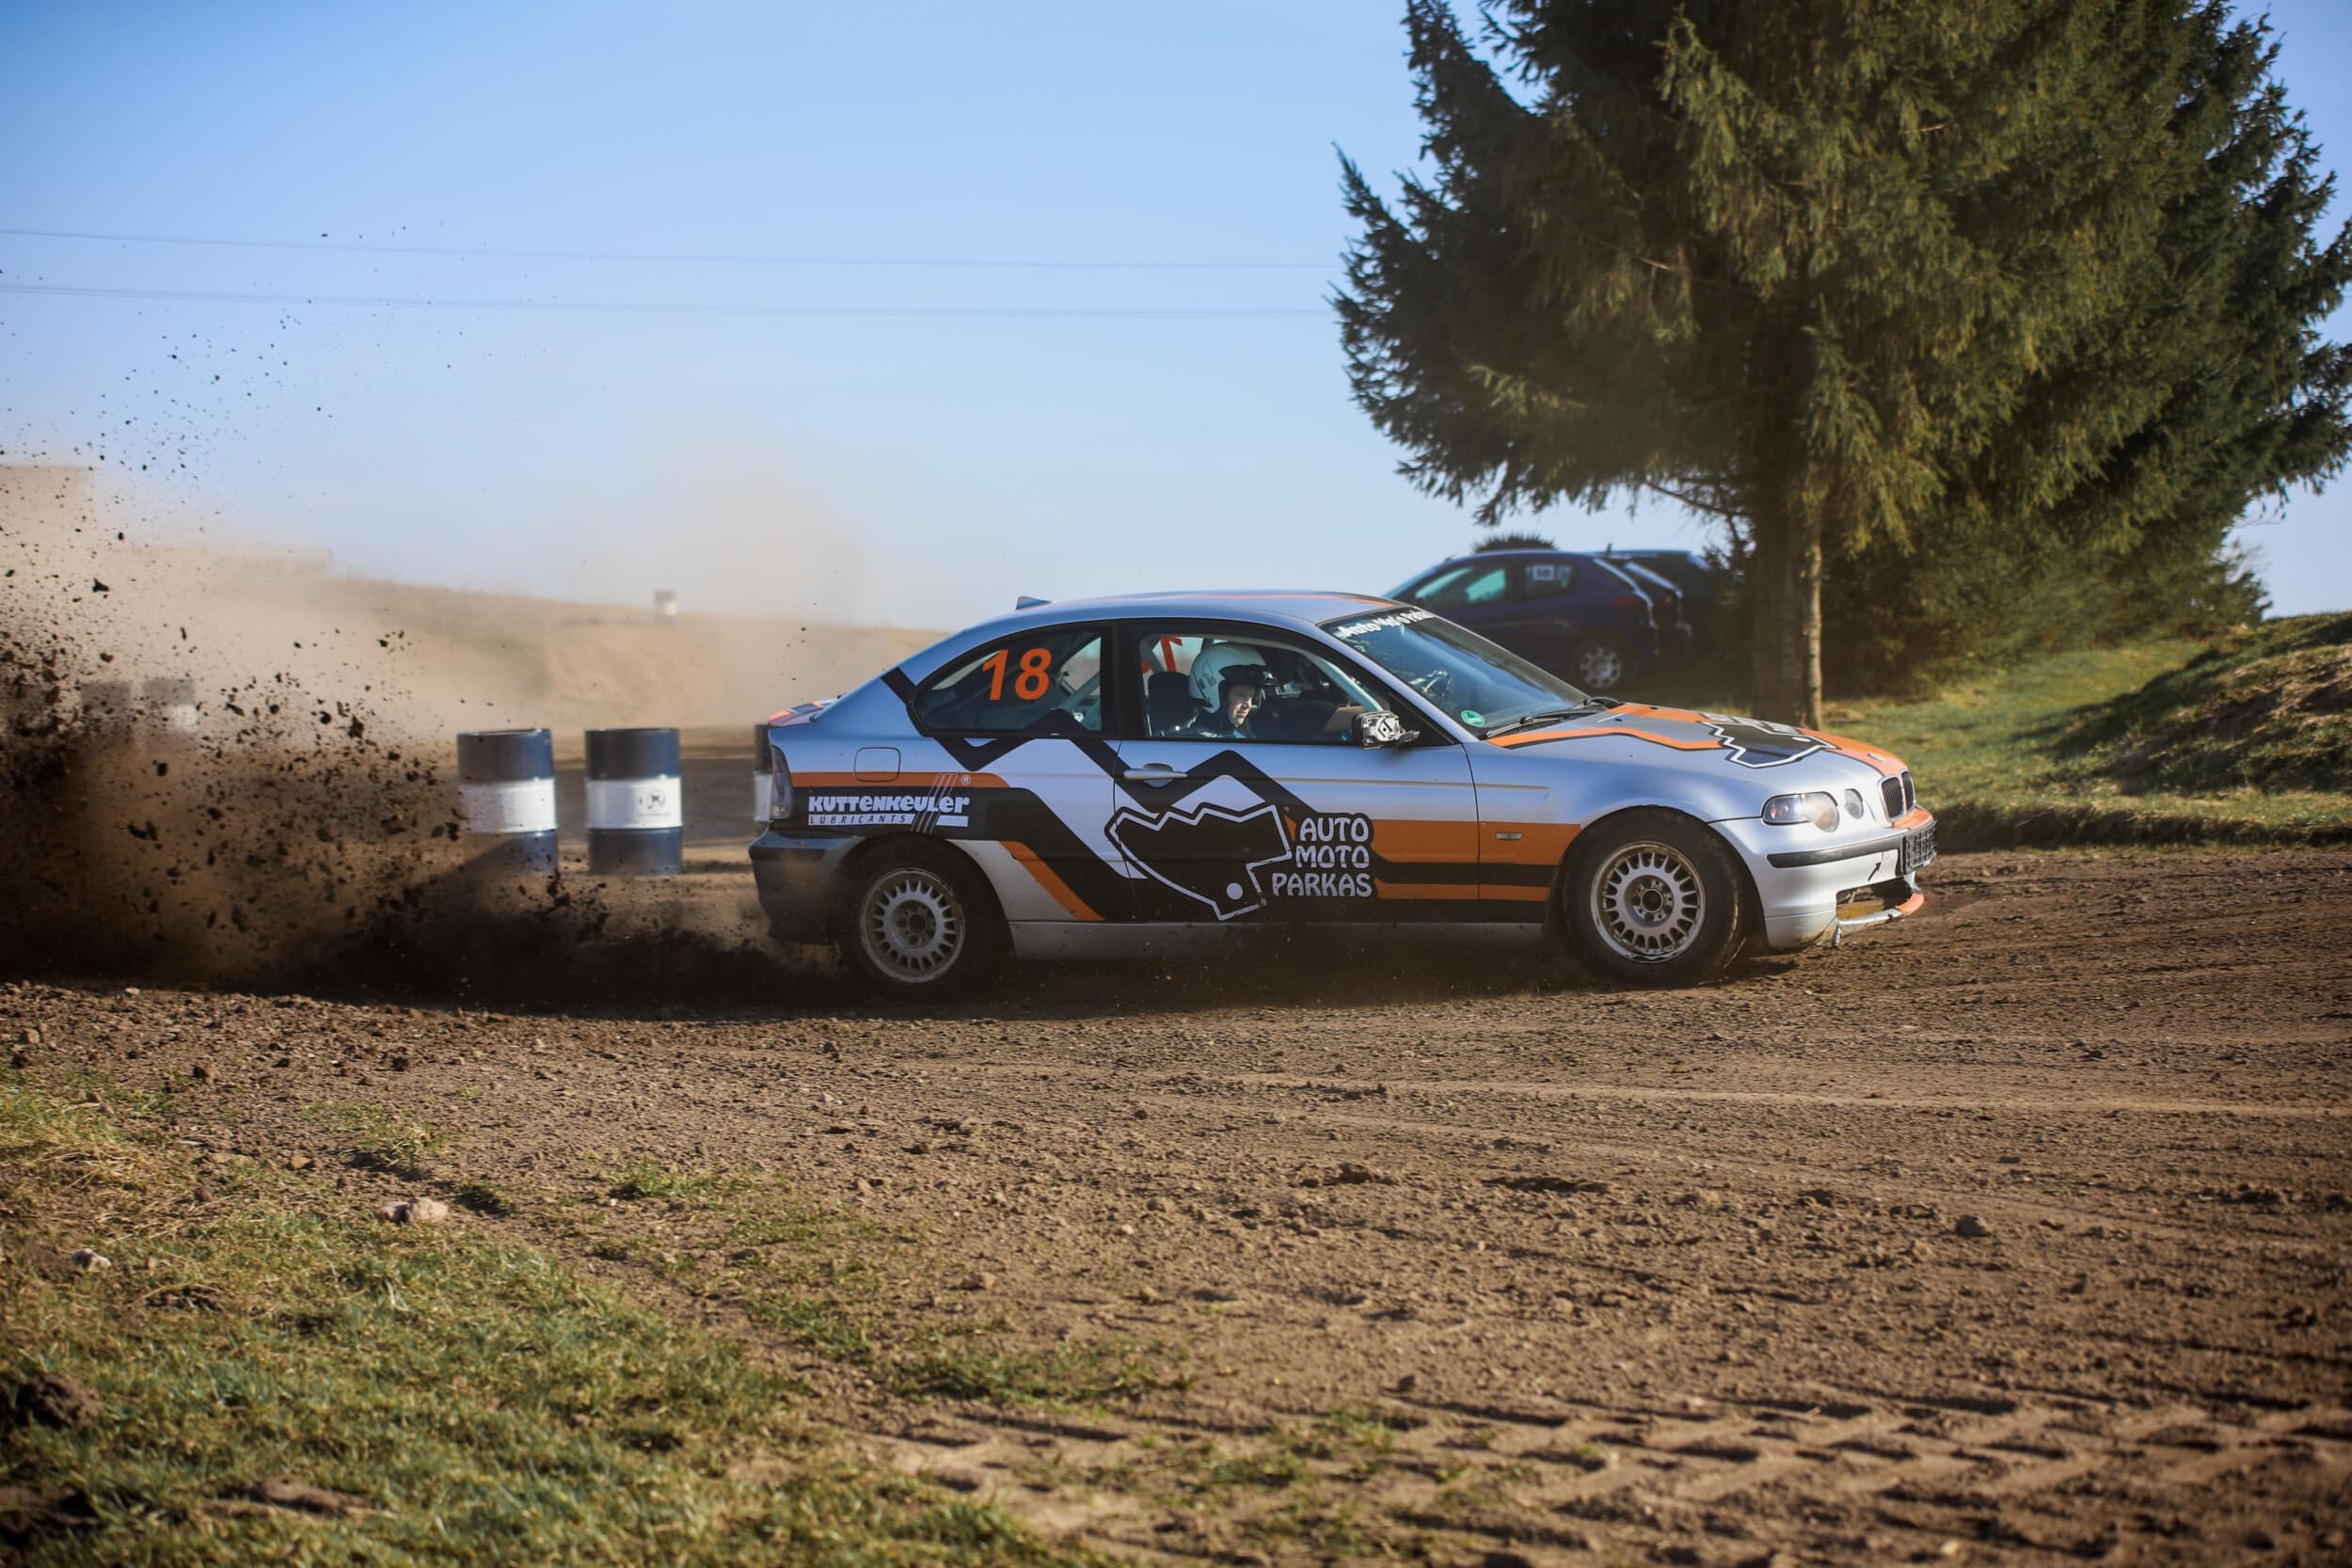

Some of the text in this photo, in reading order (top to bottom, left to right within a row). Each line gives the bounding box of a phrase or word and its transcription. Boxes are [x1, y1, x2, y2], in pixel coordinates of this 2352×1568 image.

[982, 648, 1052, 701] 18
[810, 815, 907, 825] LUBRICANTS
[1299, 817, 1369, 842] AUTO
[1295, 845, 1370, 868] MOTO
[1272, 872, 1372, 897] PARKAS
